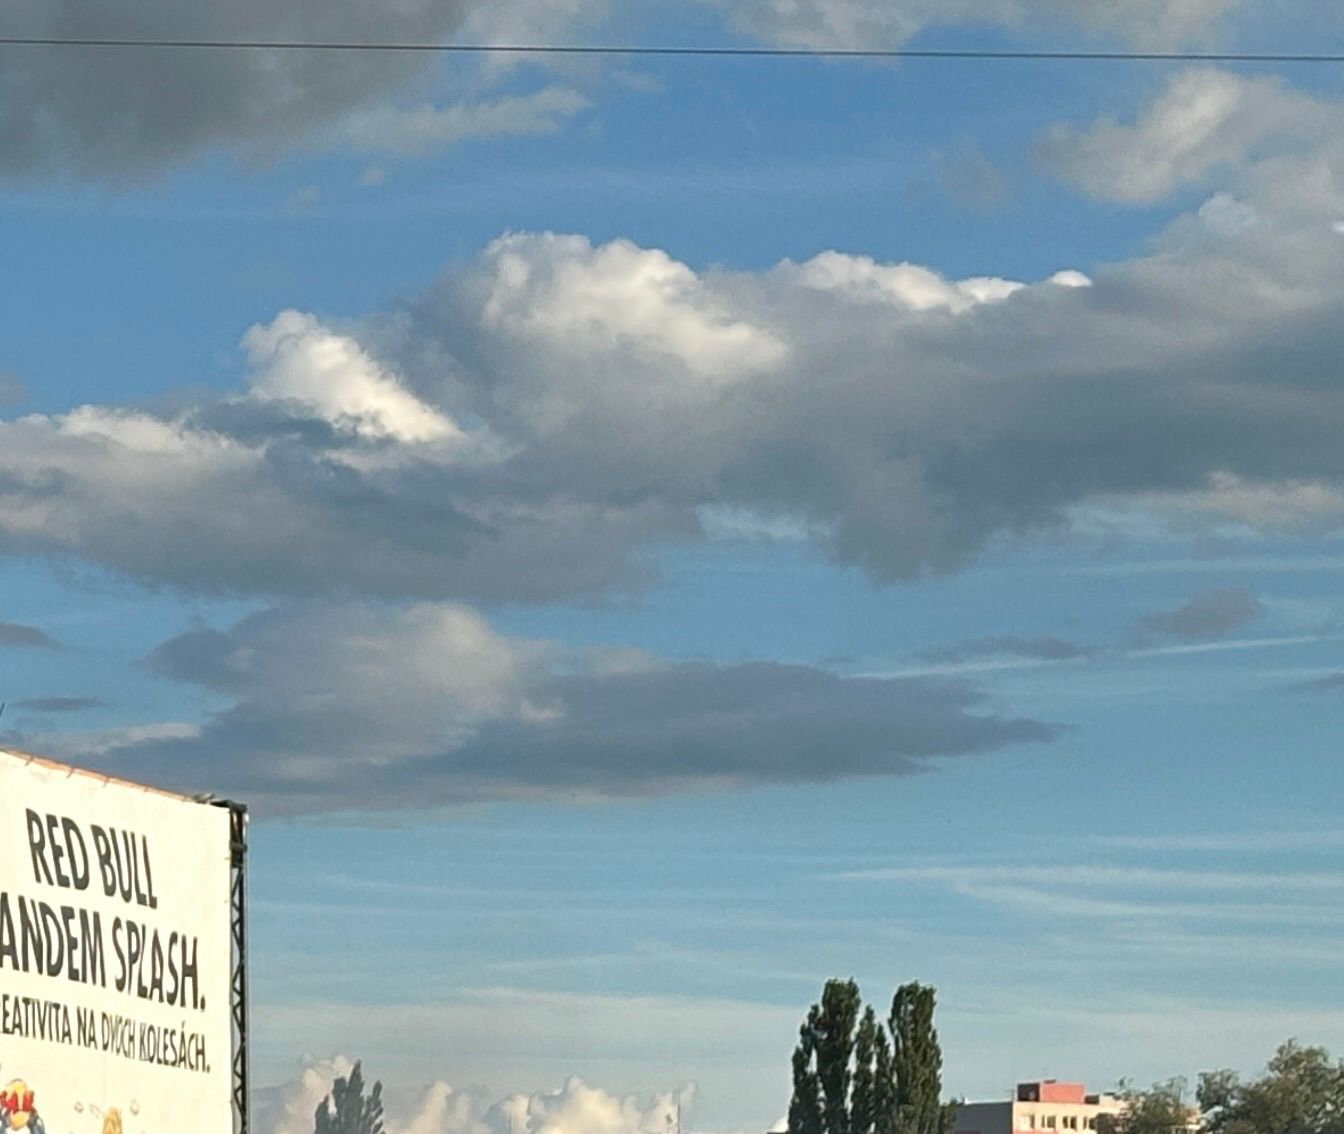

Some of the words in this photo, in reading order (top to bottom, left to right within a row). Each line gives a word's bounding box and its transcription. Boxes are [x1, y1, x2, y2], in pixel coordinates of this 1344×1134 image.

[25, 807, 90, 891] RED
[91, 823, 158, 909] BULL
[112, 916, 206, 1013] SPLASH.
[77, 1005, 98, 1050] NA
[139, 1020, 211, 1074] KOLESÁCH.
